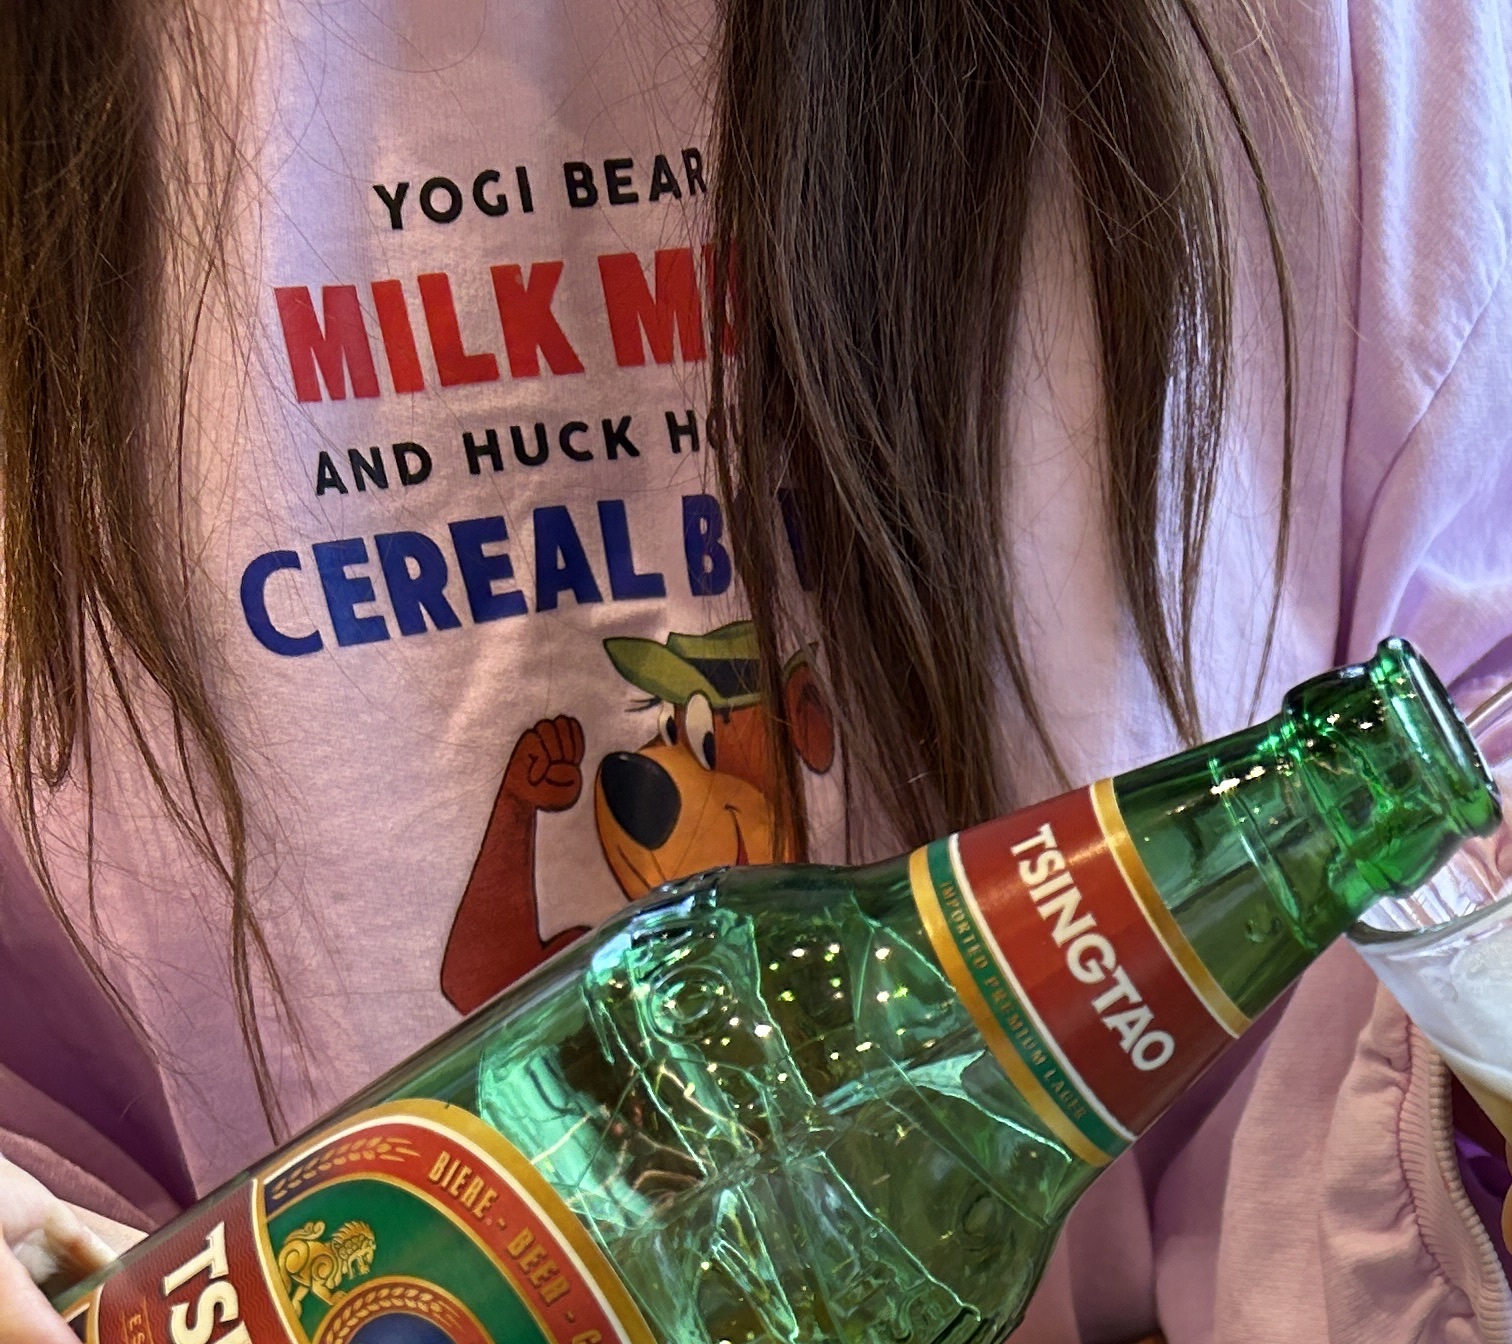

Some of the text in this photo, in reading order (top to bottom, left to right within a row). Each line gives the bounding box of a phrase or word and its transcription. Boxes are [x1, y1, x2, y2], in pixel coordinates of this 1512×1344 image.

[372, 165, 534, 230] YOGI
[273, 260, 585, 404] MILK
[315, 440, 434, 497] AND
[462, 415, 641, 476] HUCK
[240, 499, 667, 658] CEREAL
[940, 880, 1087, 1120] IMPORTED PREMIUM LAGER
[1009, 822, 1176, 1072] TSINGTAO
[428, 1150, 498, 1220] BIERE
[507, 1226, 572, 1307] BEER
